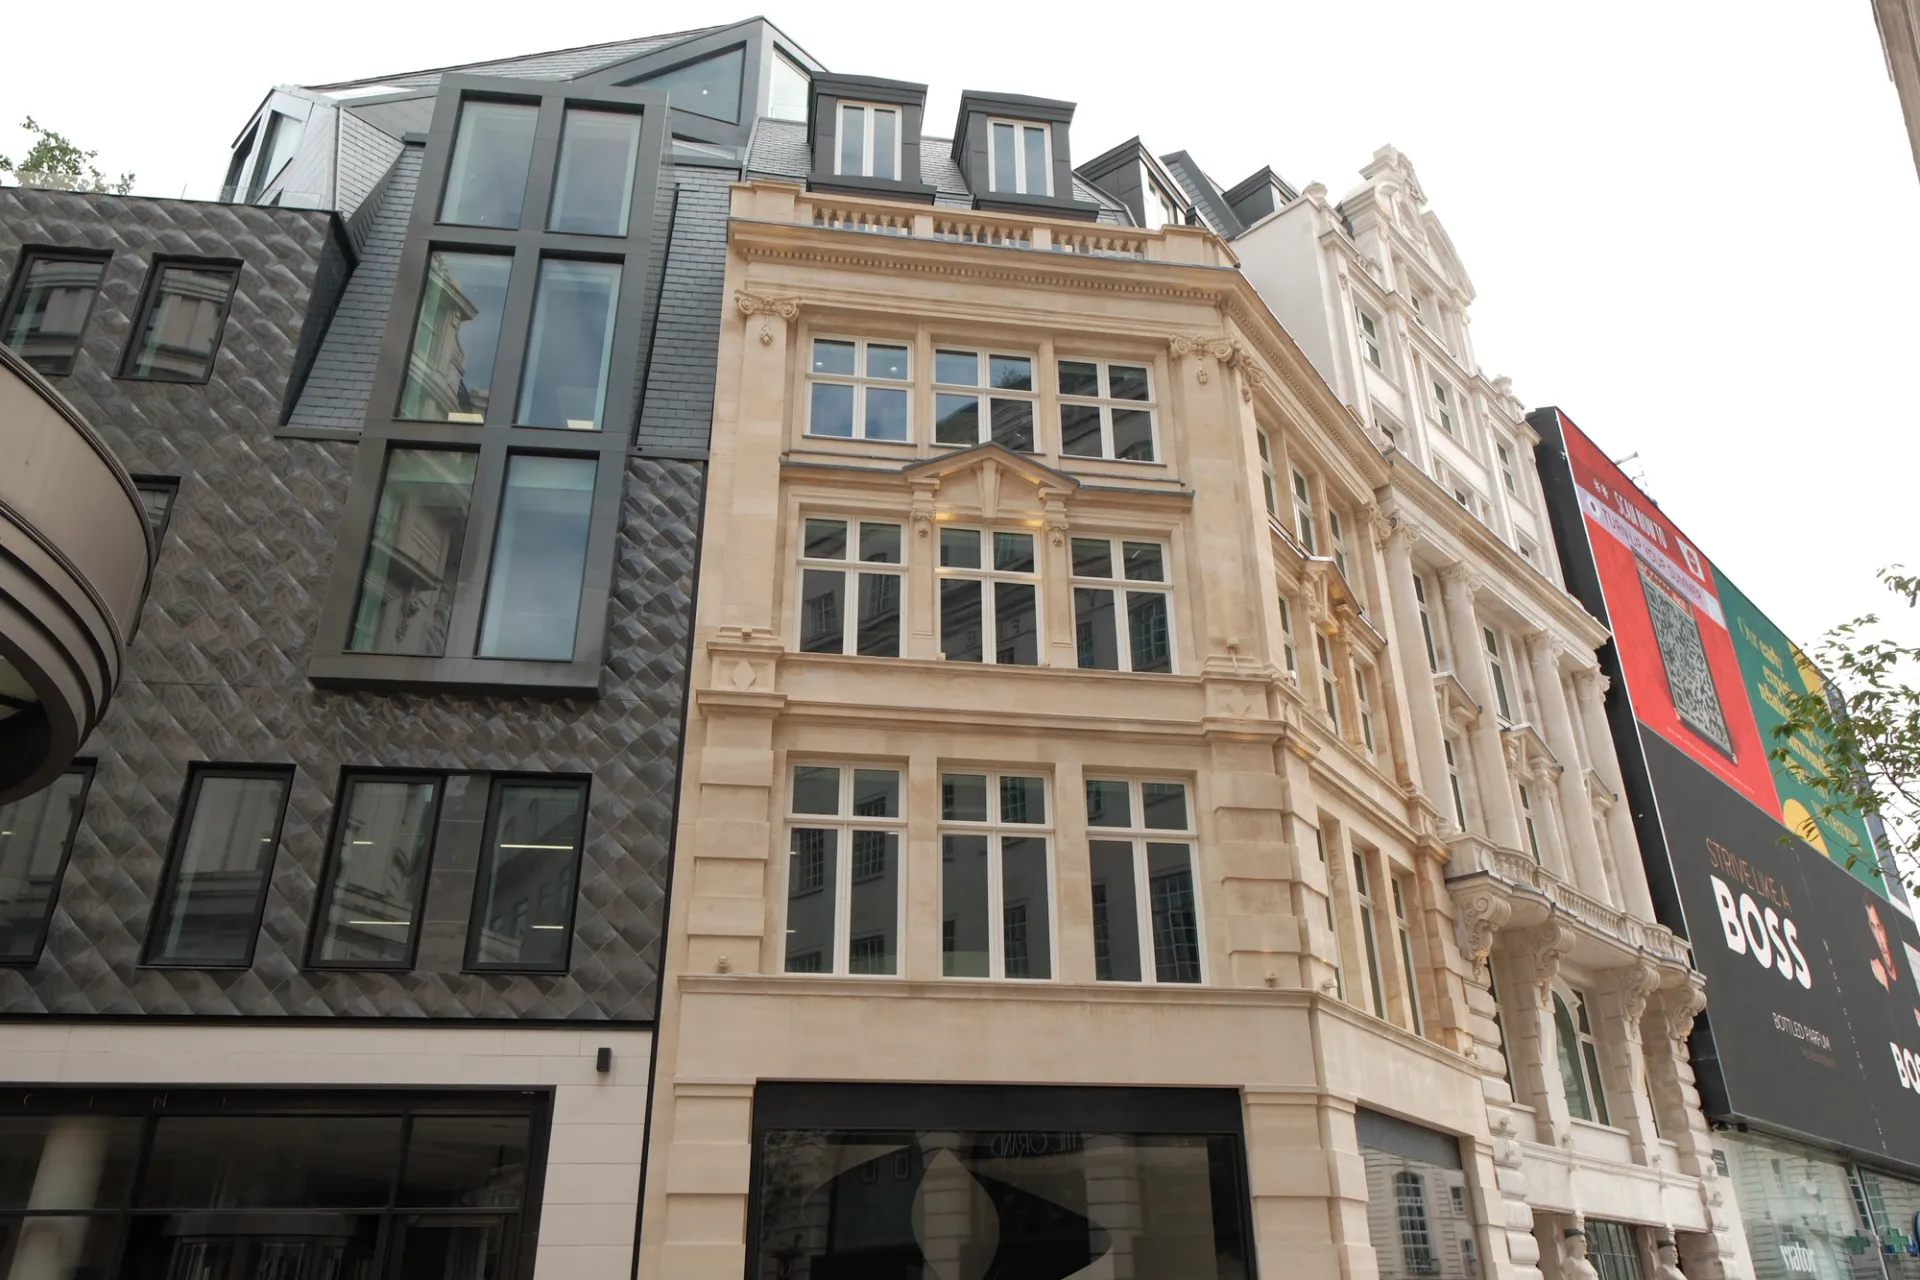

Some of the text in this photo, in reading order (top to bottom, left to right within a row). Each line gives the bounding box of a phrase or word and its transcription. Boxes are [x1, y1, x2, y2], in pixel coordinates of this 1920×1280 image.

[1602, 508, 1629, 540] TURN
[1629, 532, 1642, 548] UP
[1667, 562, 1705, 602] SUMMER
[1705, 837, 1793, 913] STRIVE LIKE A
[1709, 874, 1812, 990] BOSS
[1772, 1011, 1832, 1052] BOTTLED PARFUM
